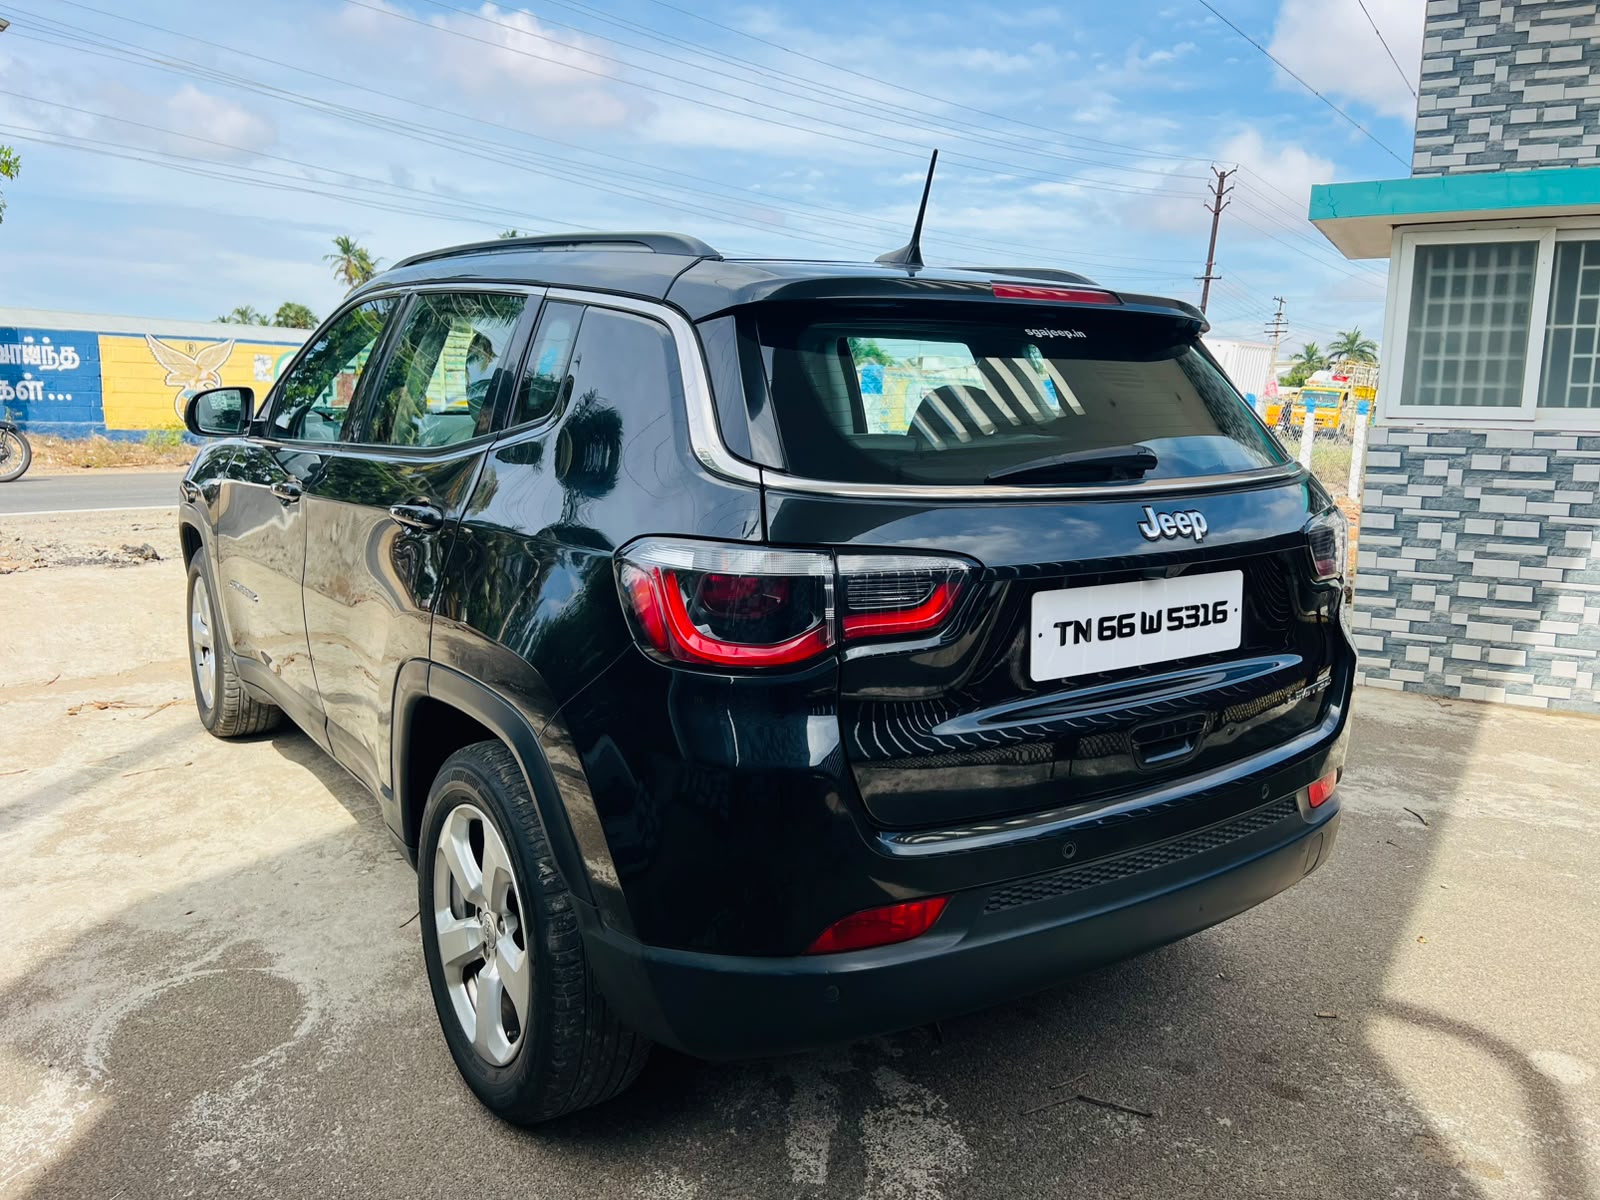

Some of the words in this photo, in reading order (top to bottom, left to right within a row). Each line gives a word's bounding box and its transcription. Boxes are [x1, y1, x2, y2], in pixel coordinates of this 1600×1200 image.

[1024, 327, 1087, 339] sgajeep.in
[1138, 505, 1208, 542] Jeep
[1053, 618, 1092, 647] TN
[1097, 612, 1136, 641] 66
[1140, 609, 1163, 635] W
[1166, 600, 1228, 631] 5316
